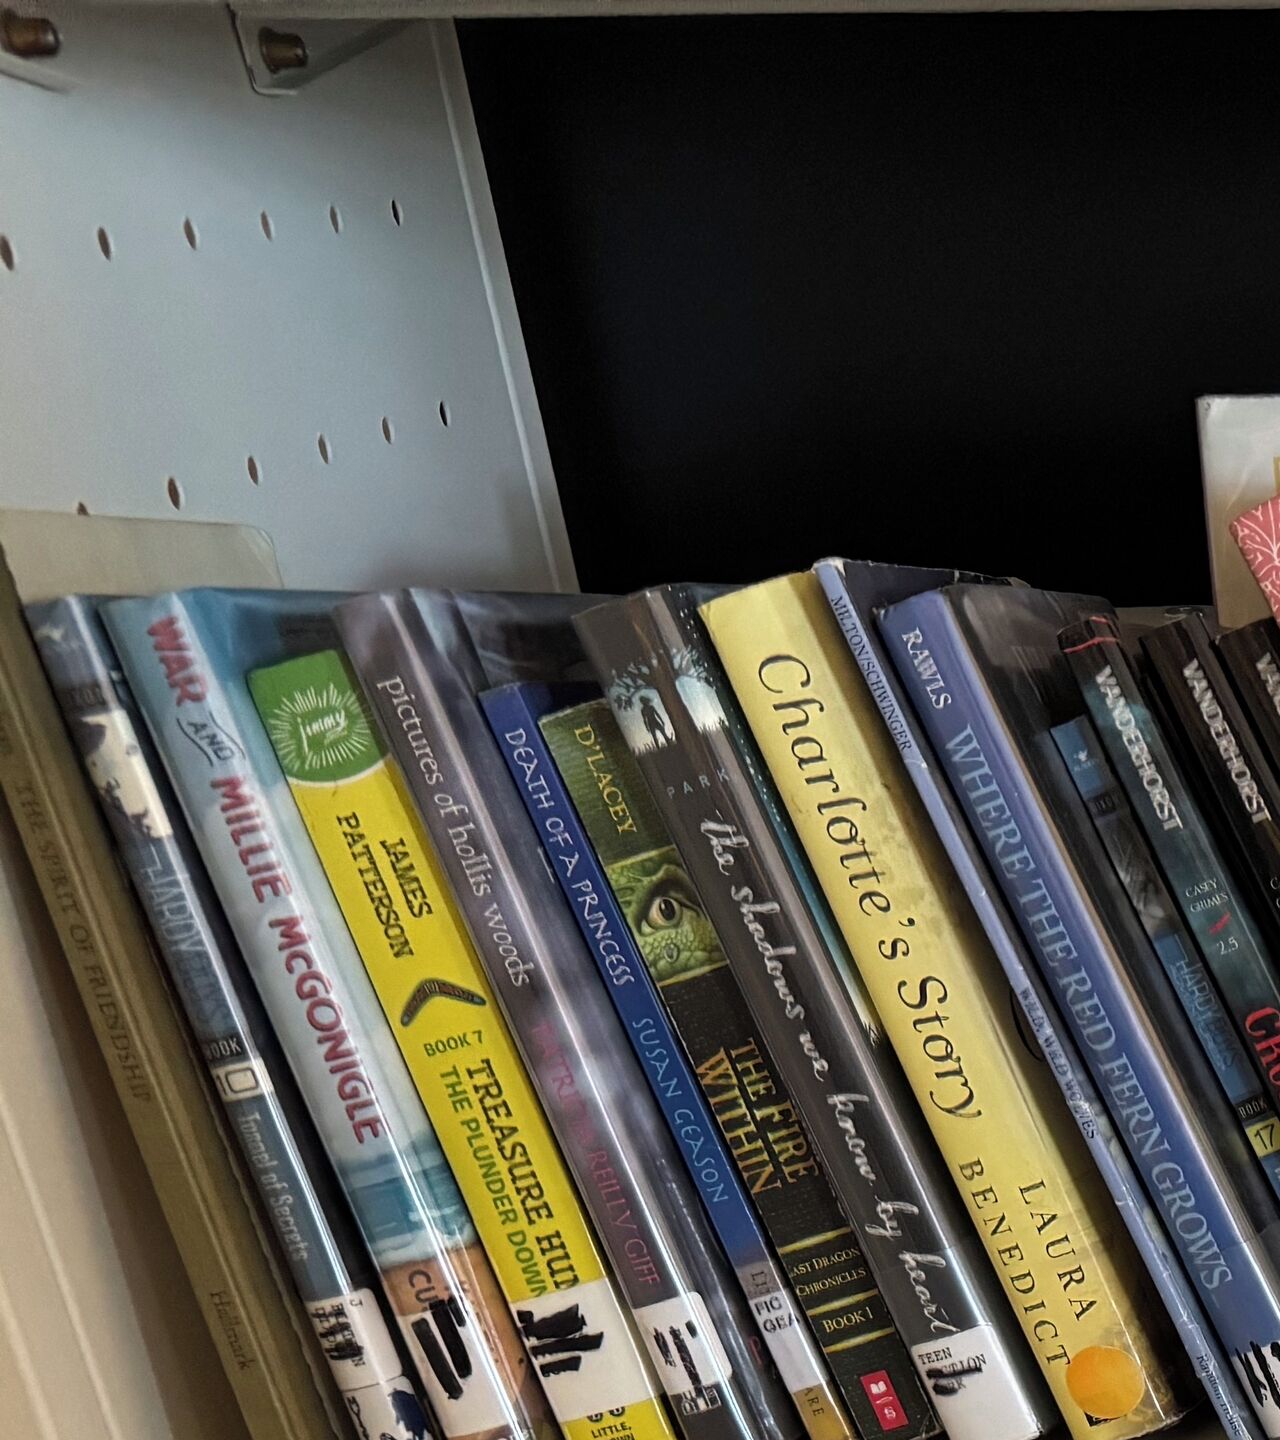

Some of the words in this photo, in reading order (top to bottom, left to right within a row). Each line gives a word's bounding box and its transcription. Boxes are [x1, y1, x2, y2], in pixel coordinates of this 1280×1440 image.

[146, 613, 209, 707] WAR
[188, 718, 234, 763] AND
[574, 723, 638, 836] D'LACEY
[667, 771, 732, 800] PARK
[210, 775, 288, 904] MILLIE
[335, 810, 414, 960] PATTERSON
[376, 674, 443, 786] pictures
[447, 821, 493, 898] hollis
[483, 901, 536, 989] woods
[379, 835, 433, 921] JAMES
[504, 727, 553, 811] DEATH
[545, 815, 577, 849] OF
[573, 879, 636, 988] PRINCESS
[757, 652, 916, 963] Charlotte's
[898, 975, 983, 1121] Story
[901, 627, 952, 711] RAWLS
[943, 724, 1032, 881] WHERE
[1016, 879, 1080, 967] THE
[1056, 965, 1117, 1053] RED
[1098, 1052, 1173, 1158] FERN
[1151, 1161, 1234, 1289] GROWS
[1216, 934, 1239, 956] 2.5
[423, 1033, 469, 1058] BOOK
[472, 1029, 484, 1045] 7
[729, 1038, 779, 1097] THE
[439, 1064, 474, 1114] THE
[460, 1116, 519, 1226] PLUNDER
[465, 1058, 554, 1226] TREASURE
[632, 1017, 683, 1099] SUSAN
[672, 1106, 728, 1204] GEASON
[694, 1048, 782, 1197] WITHIN
[1253, 1122, 1276, 1150] 17
[796, 1267, 867, 1298] CHRONICLES
[957, 1155, 1071, 1369] BENEDICT
[1018, 1178, 1100, 1321] LAURA
[822, 1312, 865, 1334] BOOK
[917, 1346, 953, 1366] TEEN
[590, 1421, 633, 1440] LITTLE,
